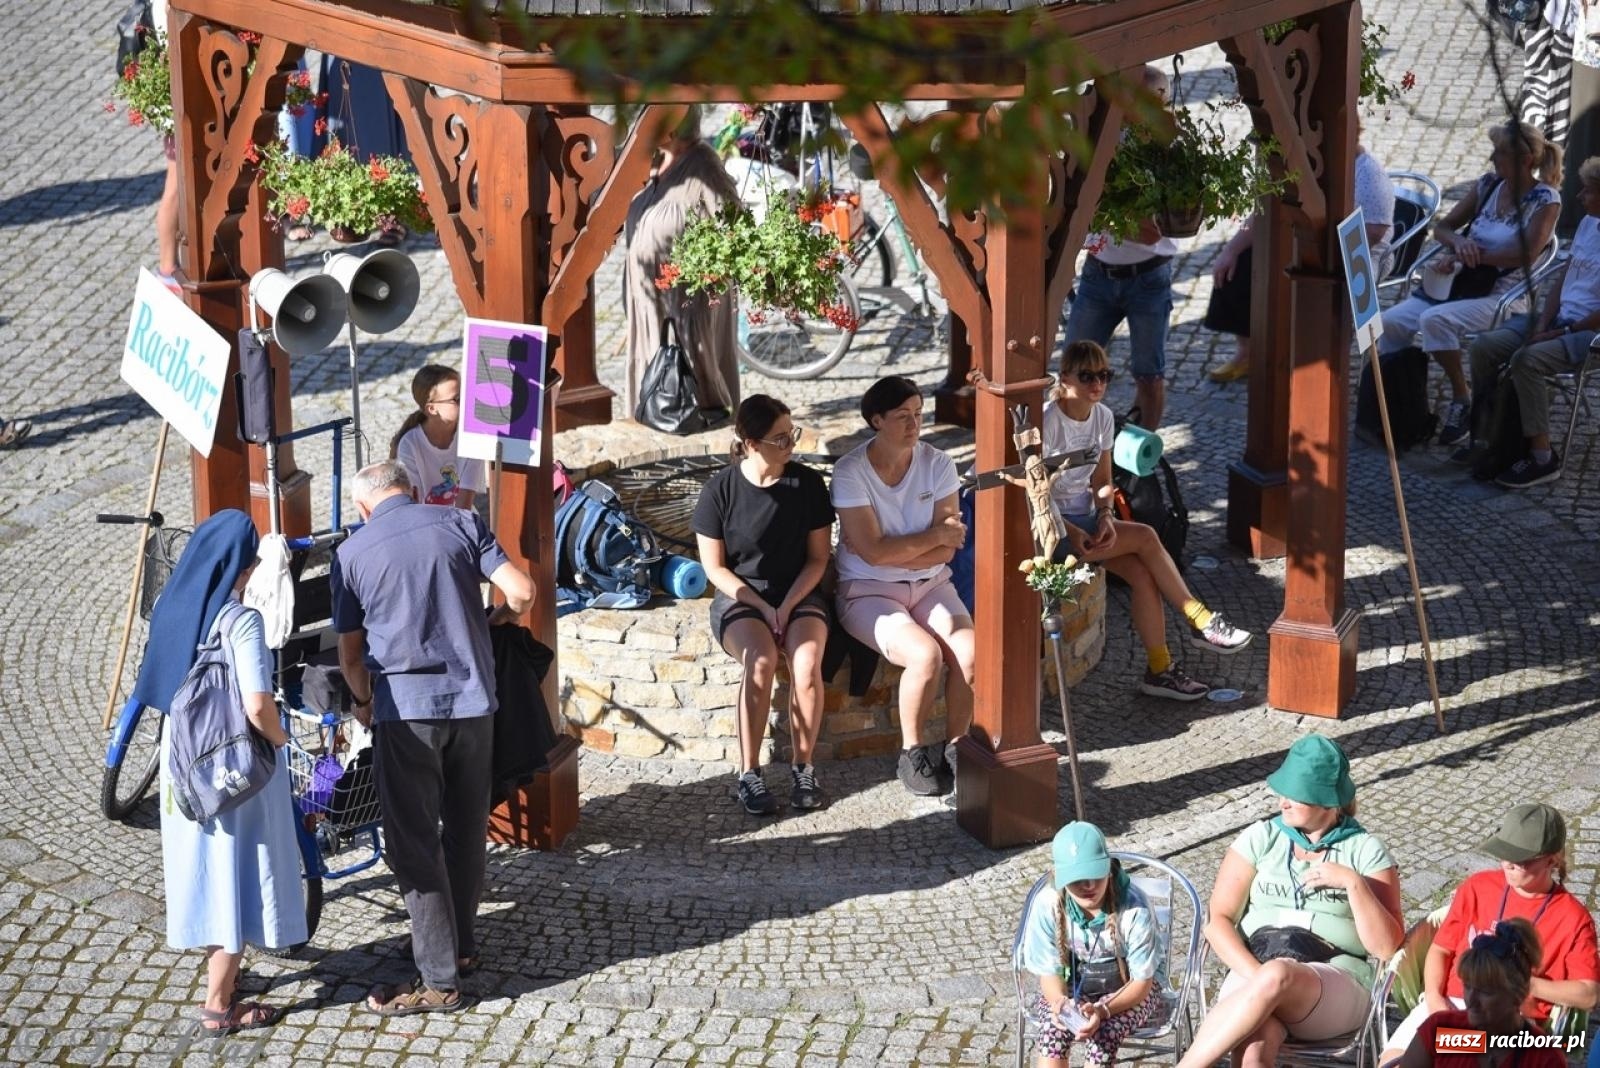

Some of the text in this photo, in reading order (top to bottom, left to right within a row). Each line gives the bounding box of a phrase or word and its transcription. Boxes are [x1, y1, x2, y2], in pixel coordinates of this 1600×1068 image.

[1345, 225, 1372, 314] 5
[129, 300, 219, 430] Racibórz
[474, 335, 530, 426] 5
[1257, 881, 1293, 899] NEW
